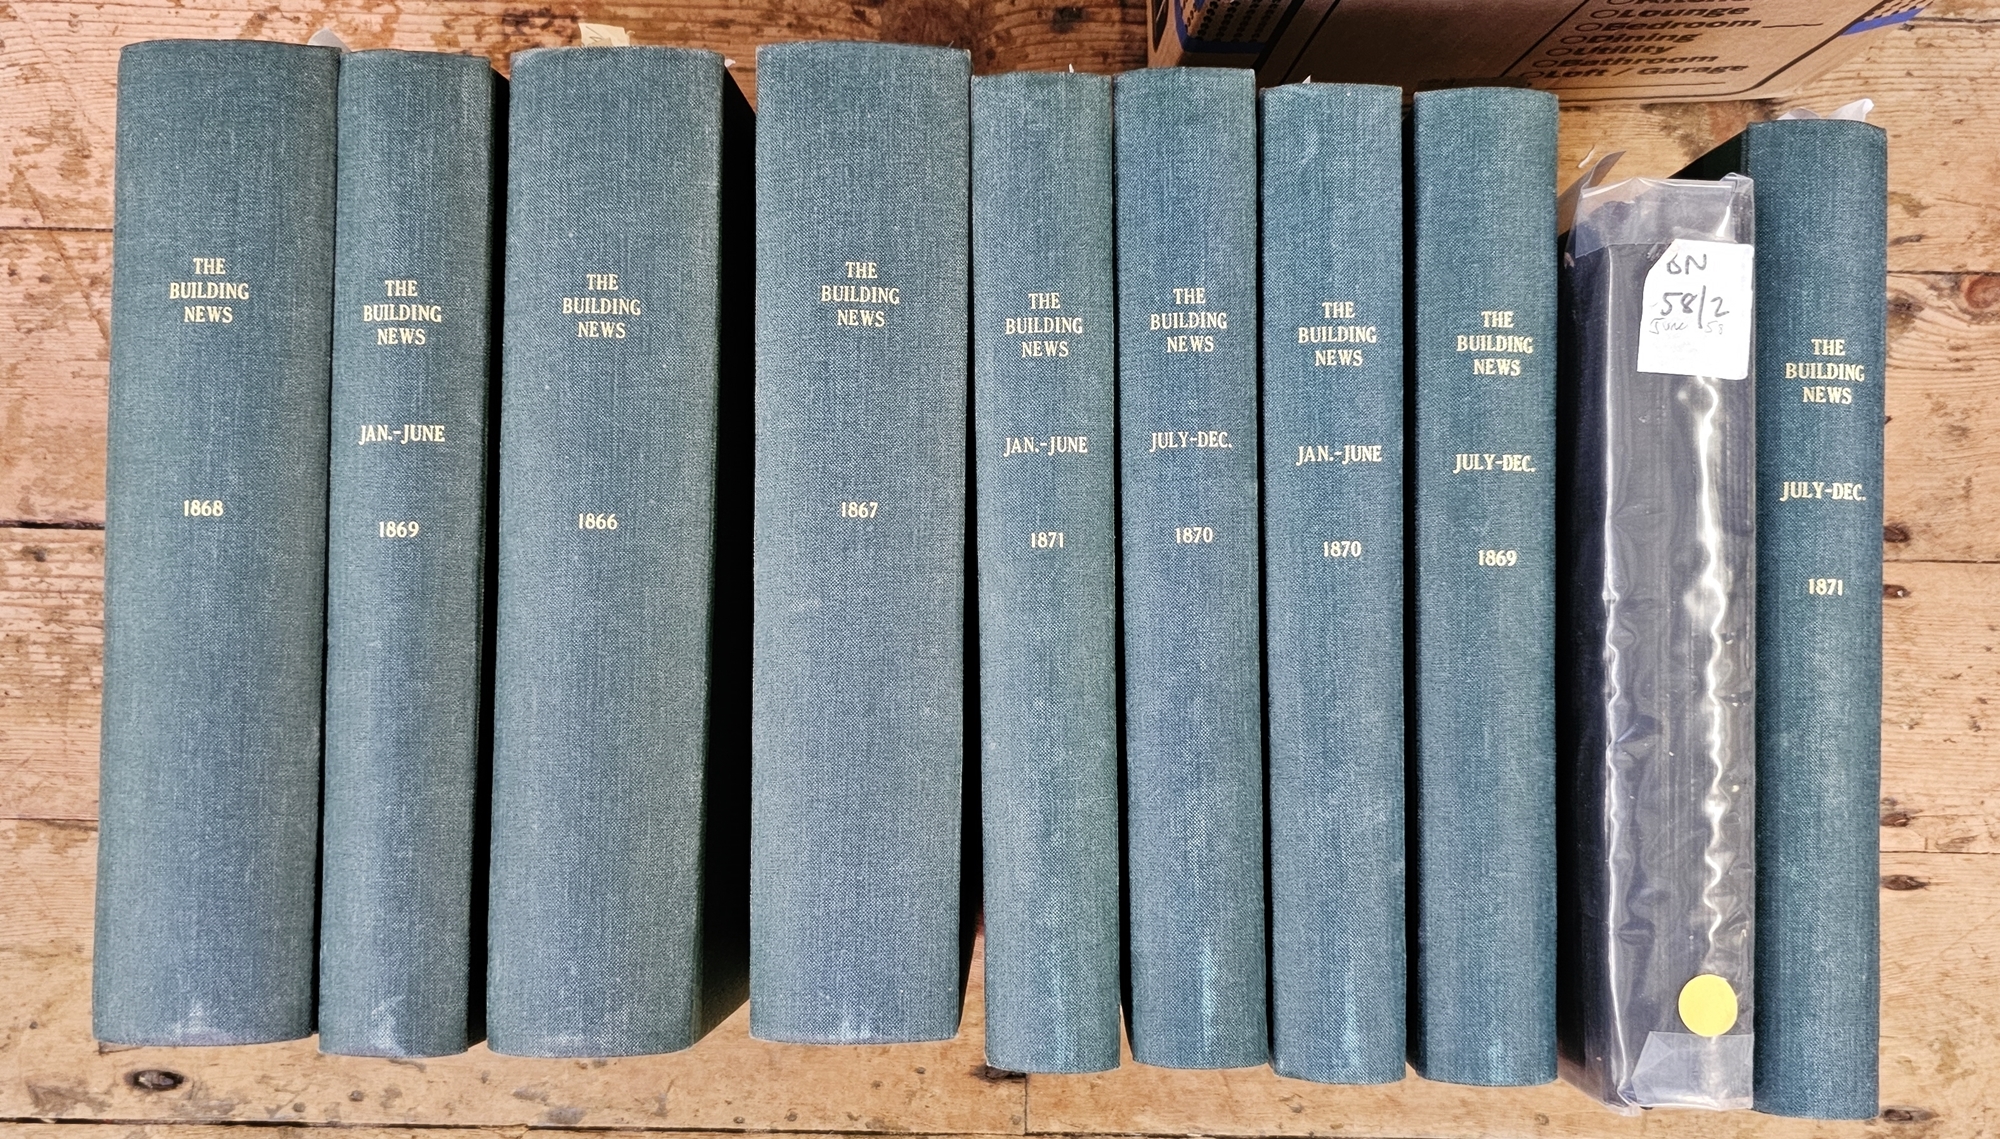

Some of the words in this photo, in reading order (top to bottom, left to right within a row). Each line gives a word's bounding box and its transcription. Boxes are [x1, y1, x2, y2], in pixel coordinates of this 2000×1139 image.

[1617, 7, 1750, 18] Lounge
[1601, 20, 1762, 31] Bedroom
[1586, 32, 1703, 43] Dining
[1573, 45, 1677, 55] Utility
[1557, 56, 1718, 67] Bathroom
[1544, 68, 1610, 78] Loft
[1637, 65, 1749, 75] Garage
[193, 257, 226, 275] THE
[846, 261, 878, 279] THE
[169, 282, 250, 300] BUILDING
[385, 280, 418, 297] THE
[586, 274, 618, 291] THE
[821, 286, 900, 305] BUILDING
[1028, 293, 1060, 309] THE
[1173, 288, 1206, 304] THE
[183, 306, 233, 324] NEWS
[363, 304, 442, 323] BUILDING
[562, 298, 641, 316] BUILDING
[1322, 302, 1355, 319] THE
[837, 310, 885, 328] NEWS
[1005, 318, 1083, 335] BUILDING
[1150, 312, 1228, 330] BUILDING
[1481, 311, 1514, 328] THE
[377, 328, 426, 345] NEWS
[577, 321, 626, 339] NEWS
[1298, 326, 1377, 344] BUILDING
[1021, 342, 1069, 358] NEWS
[1166, 336, 1214, 353] NEWS
[1457, 335, 1533, 354] BUILDING
[1811, 339, 1845, 356] THE
[1315, 350, 1363, 367] NEWS
[1473, 359, 1521, 376] NEWS
[1785, 363, 1865, 382] BUILDING
[1803, 387, 1852, 404] NEWS
[358, 424, 445, 445] JAN.-JUNE
[1150, 432, 1233, 452] JULY-DEC.
[1003, 437, 1088, 457] JAN.-JUNE
[1296, 445, 1382, 466] JAN.-JUNE
[1453, 454, 1535, 473] JULY-DEC.
[1780, 482, 1866, 501] JULY-DEC.
[183, 499, 224, 517] 1868
[841, 502, 878, 519] 1867
[378, 521, 419, 538] 1869
[578, 513, 617, 531] 1866
[1030, 532, 1064, 549] 1871
[1175, 527, 1213, 544] 1870
[1323, 540, 1361, 557] 1870
[1478, 550, 1517, 567] 1869
[1808, 578, 1843, 596] 1871
